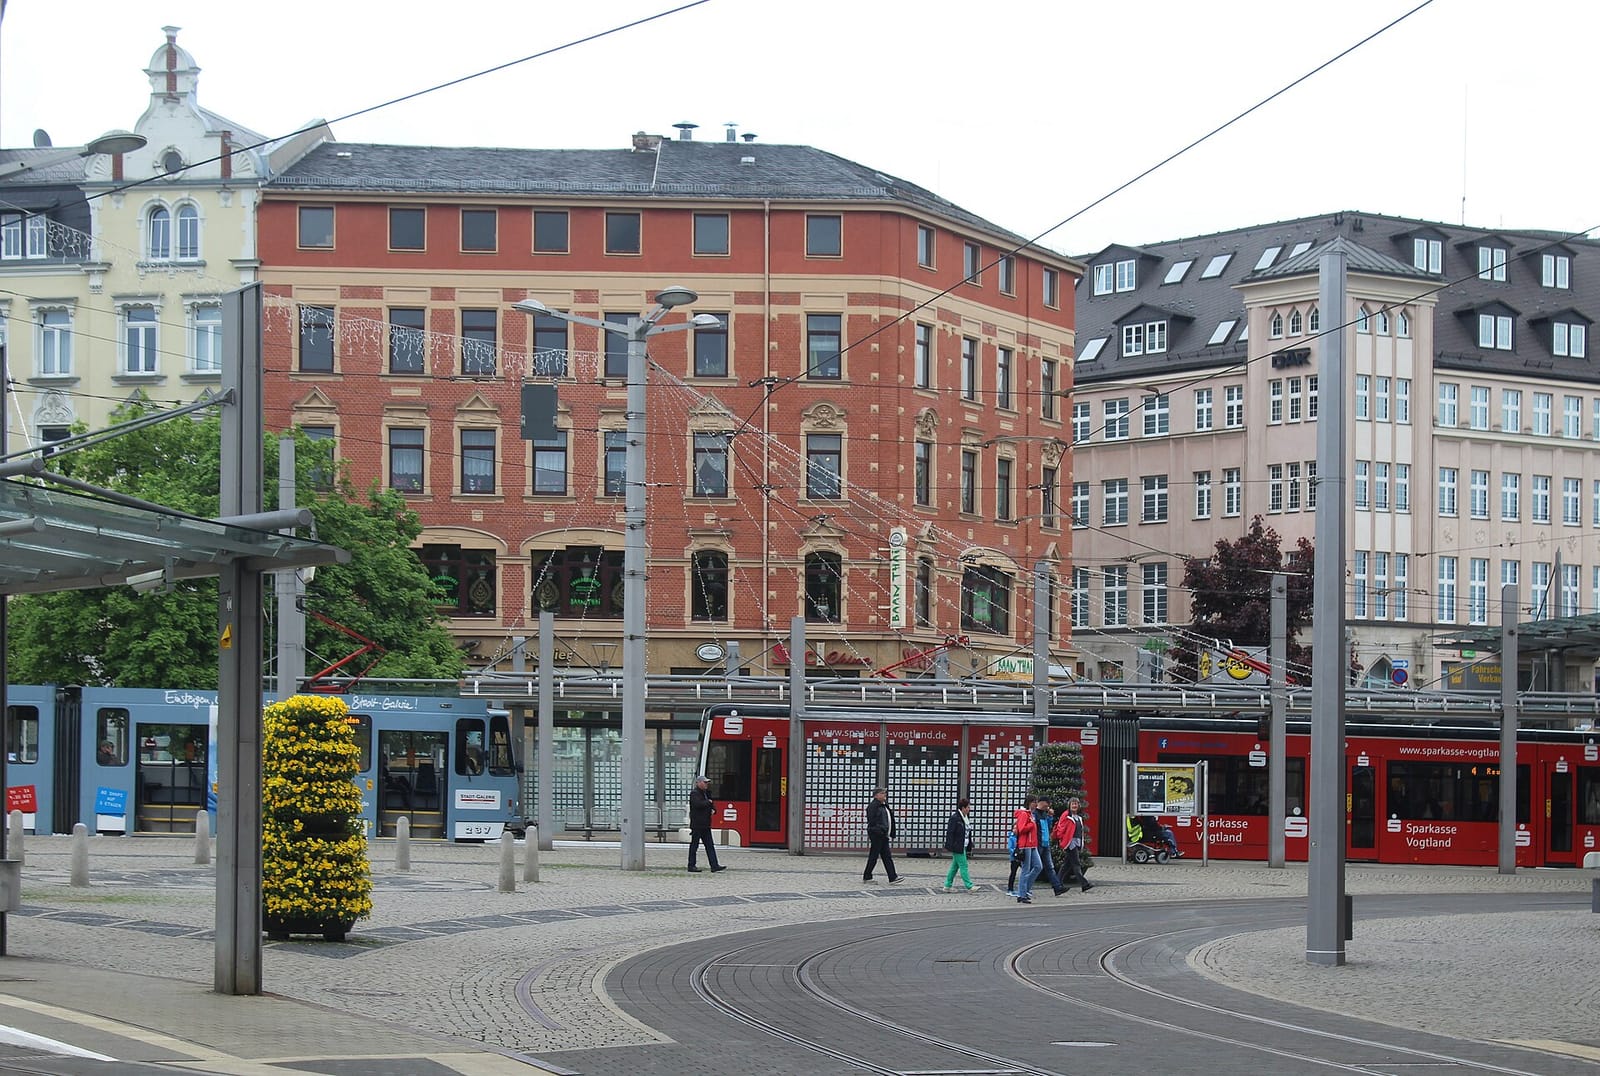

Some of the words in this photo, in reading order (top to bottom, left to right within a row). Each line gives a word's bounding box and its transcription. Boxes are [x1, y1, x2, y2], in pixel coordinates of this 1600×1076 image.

[1272, 349, 1311, 369] DAK
[891, 549, 901, 582] THAI
[891, 583, 900, 622] BAAN
[1196, 818, 1248, 829] Sarkasse
[1406, 823, 1457, 836] Sparkasse
[465, 826, 491, 835] 237
[1196, 831, 1242, 844] Vgtland
[1406, 837, 1452, 850] Vogtland
